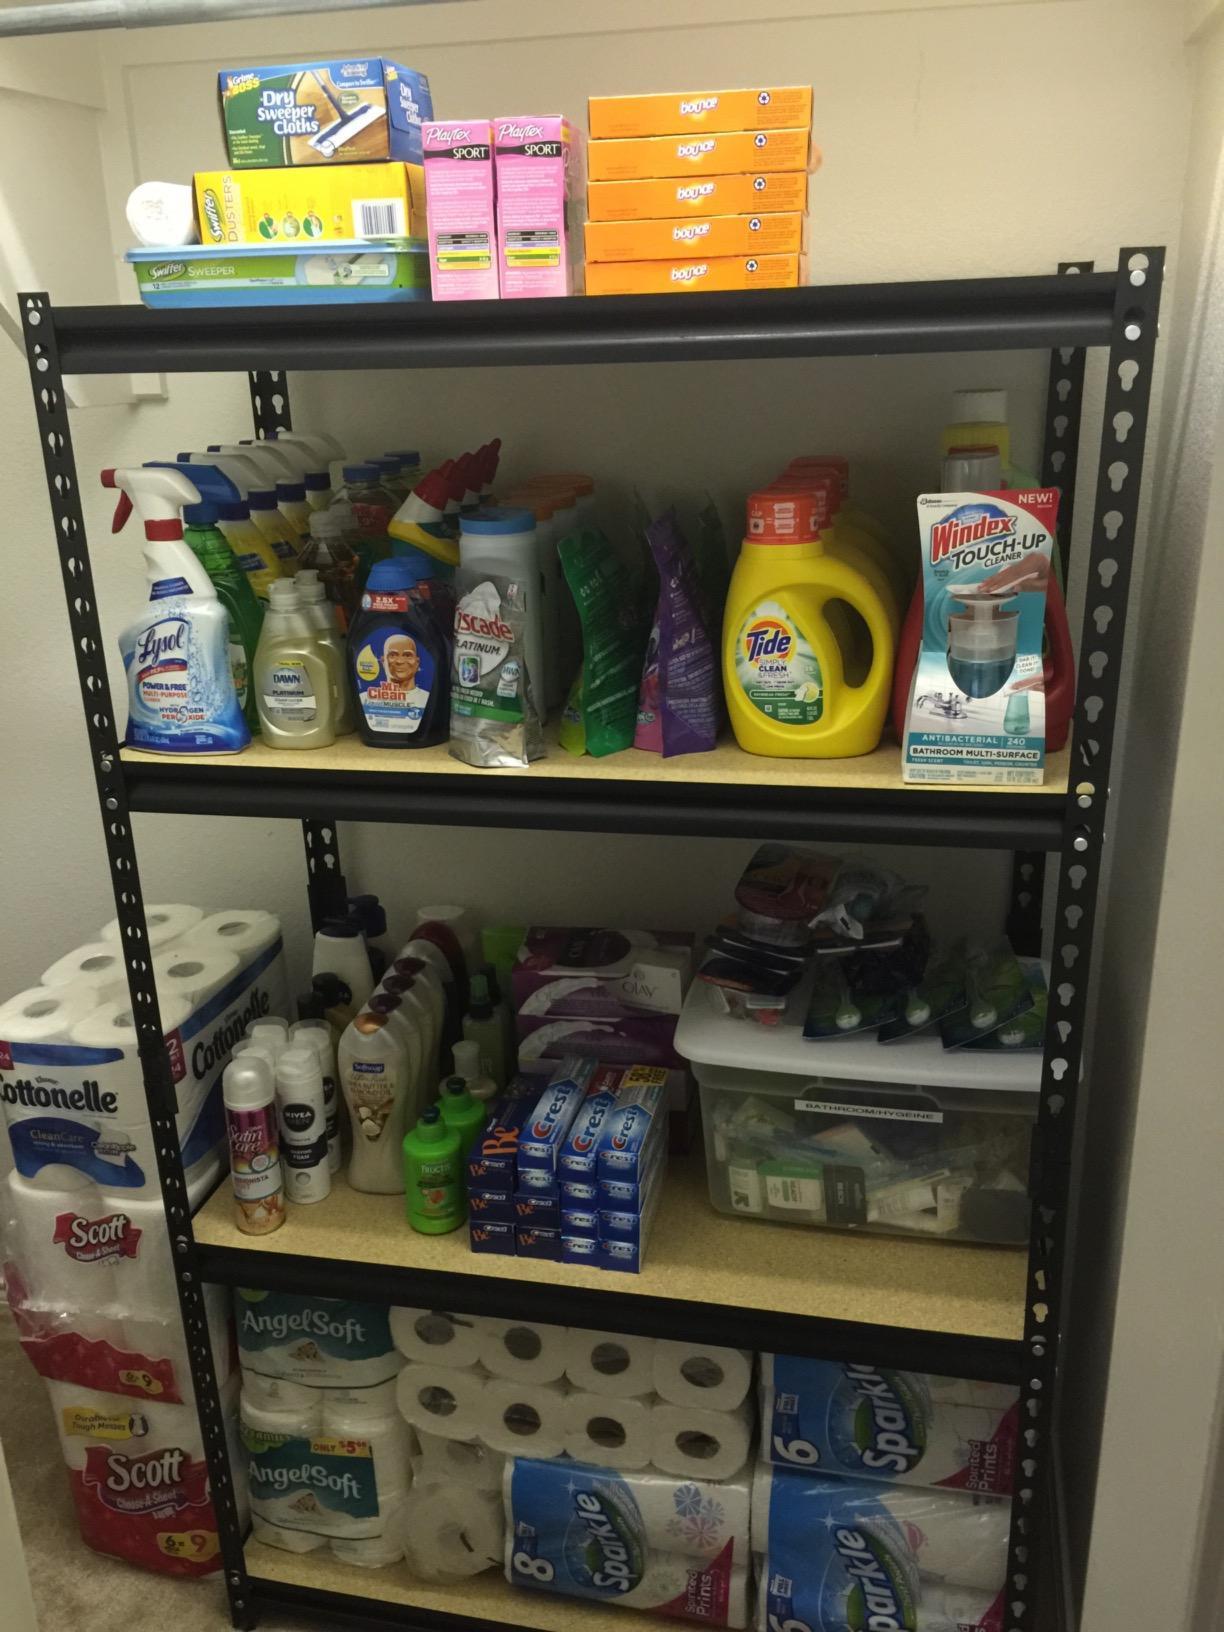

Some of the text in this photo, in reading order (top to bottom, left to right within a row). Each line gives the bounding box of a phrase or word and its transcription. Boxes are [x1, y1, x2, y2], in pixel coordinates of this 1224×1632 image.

[257, 105, 315, 122] Sweeper
[263, 90, 295, 107] Dry
[273, 118, 320, 135] Cloths
[427, 127, 471, 145] Playtex
[499, 124, 543, 142] Playtex
[453, 147, 485, 159] SPORT
[524, 144, 557, 155] SPORT
[204, 191, 223, 240] Swiffer
[223, 175, 238, 242] DUSTERS
[150, 263, 182, 280] Swiffer
[1018, 493, 1053, 504] NEW!
[931, 513, 1015, 563] Windex
[951, 533, 1047, 570] TOUCH-UP
[984, 552, 1022, 568] CLEANER
[456, 611, 514, 641] scade
[138, 623, 185, 666] Lysol
[746, 629, 791, 662] Tide
[273, 674, 300, 684] DAWN
[367, 687, 407, 701] Clean
[912, 747, 1038, 760] BATHROOM MULTI-SURFACE
[922, 734, 1026, 746] ANTIBACTERIAL 240
[191, 986, 271, 1080] Cottonelle
[532, 1084, 571, 1139] Crest
[572, 1099, 610, 1152] Crest
[611, 1107, 638, 1151] Crest
[519, 1143, 551, 1154] Crest
[600, 1151, 637, 1162] Crest
[70, 1215, 127, 1247] Scott
[774, 1436, 819, 1465] 6
[966, 1439, 982, 1488] Spirited
[107, 1449, 184, 1492] Scott
[979, 1443, 998, 1492] Prints
[165, 1536, 177, 1547] 6
[190, 1534, 207, 1552] 9
[576, 1493, 638, 1592] Sparkle
[513, 1552, 554, 1582] 8
[829, 1527, 900, 1632] parkle
[685, 1568, 698, 1614] Spirited
[696, 1574, 713, 1617] Prints
